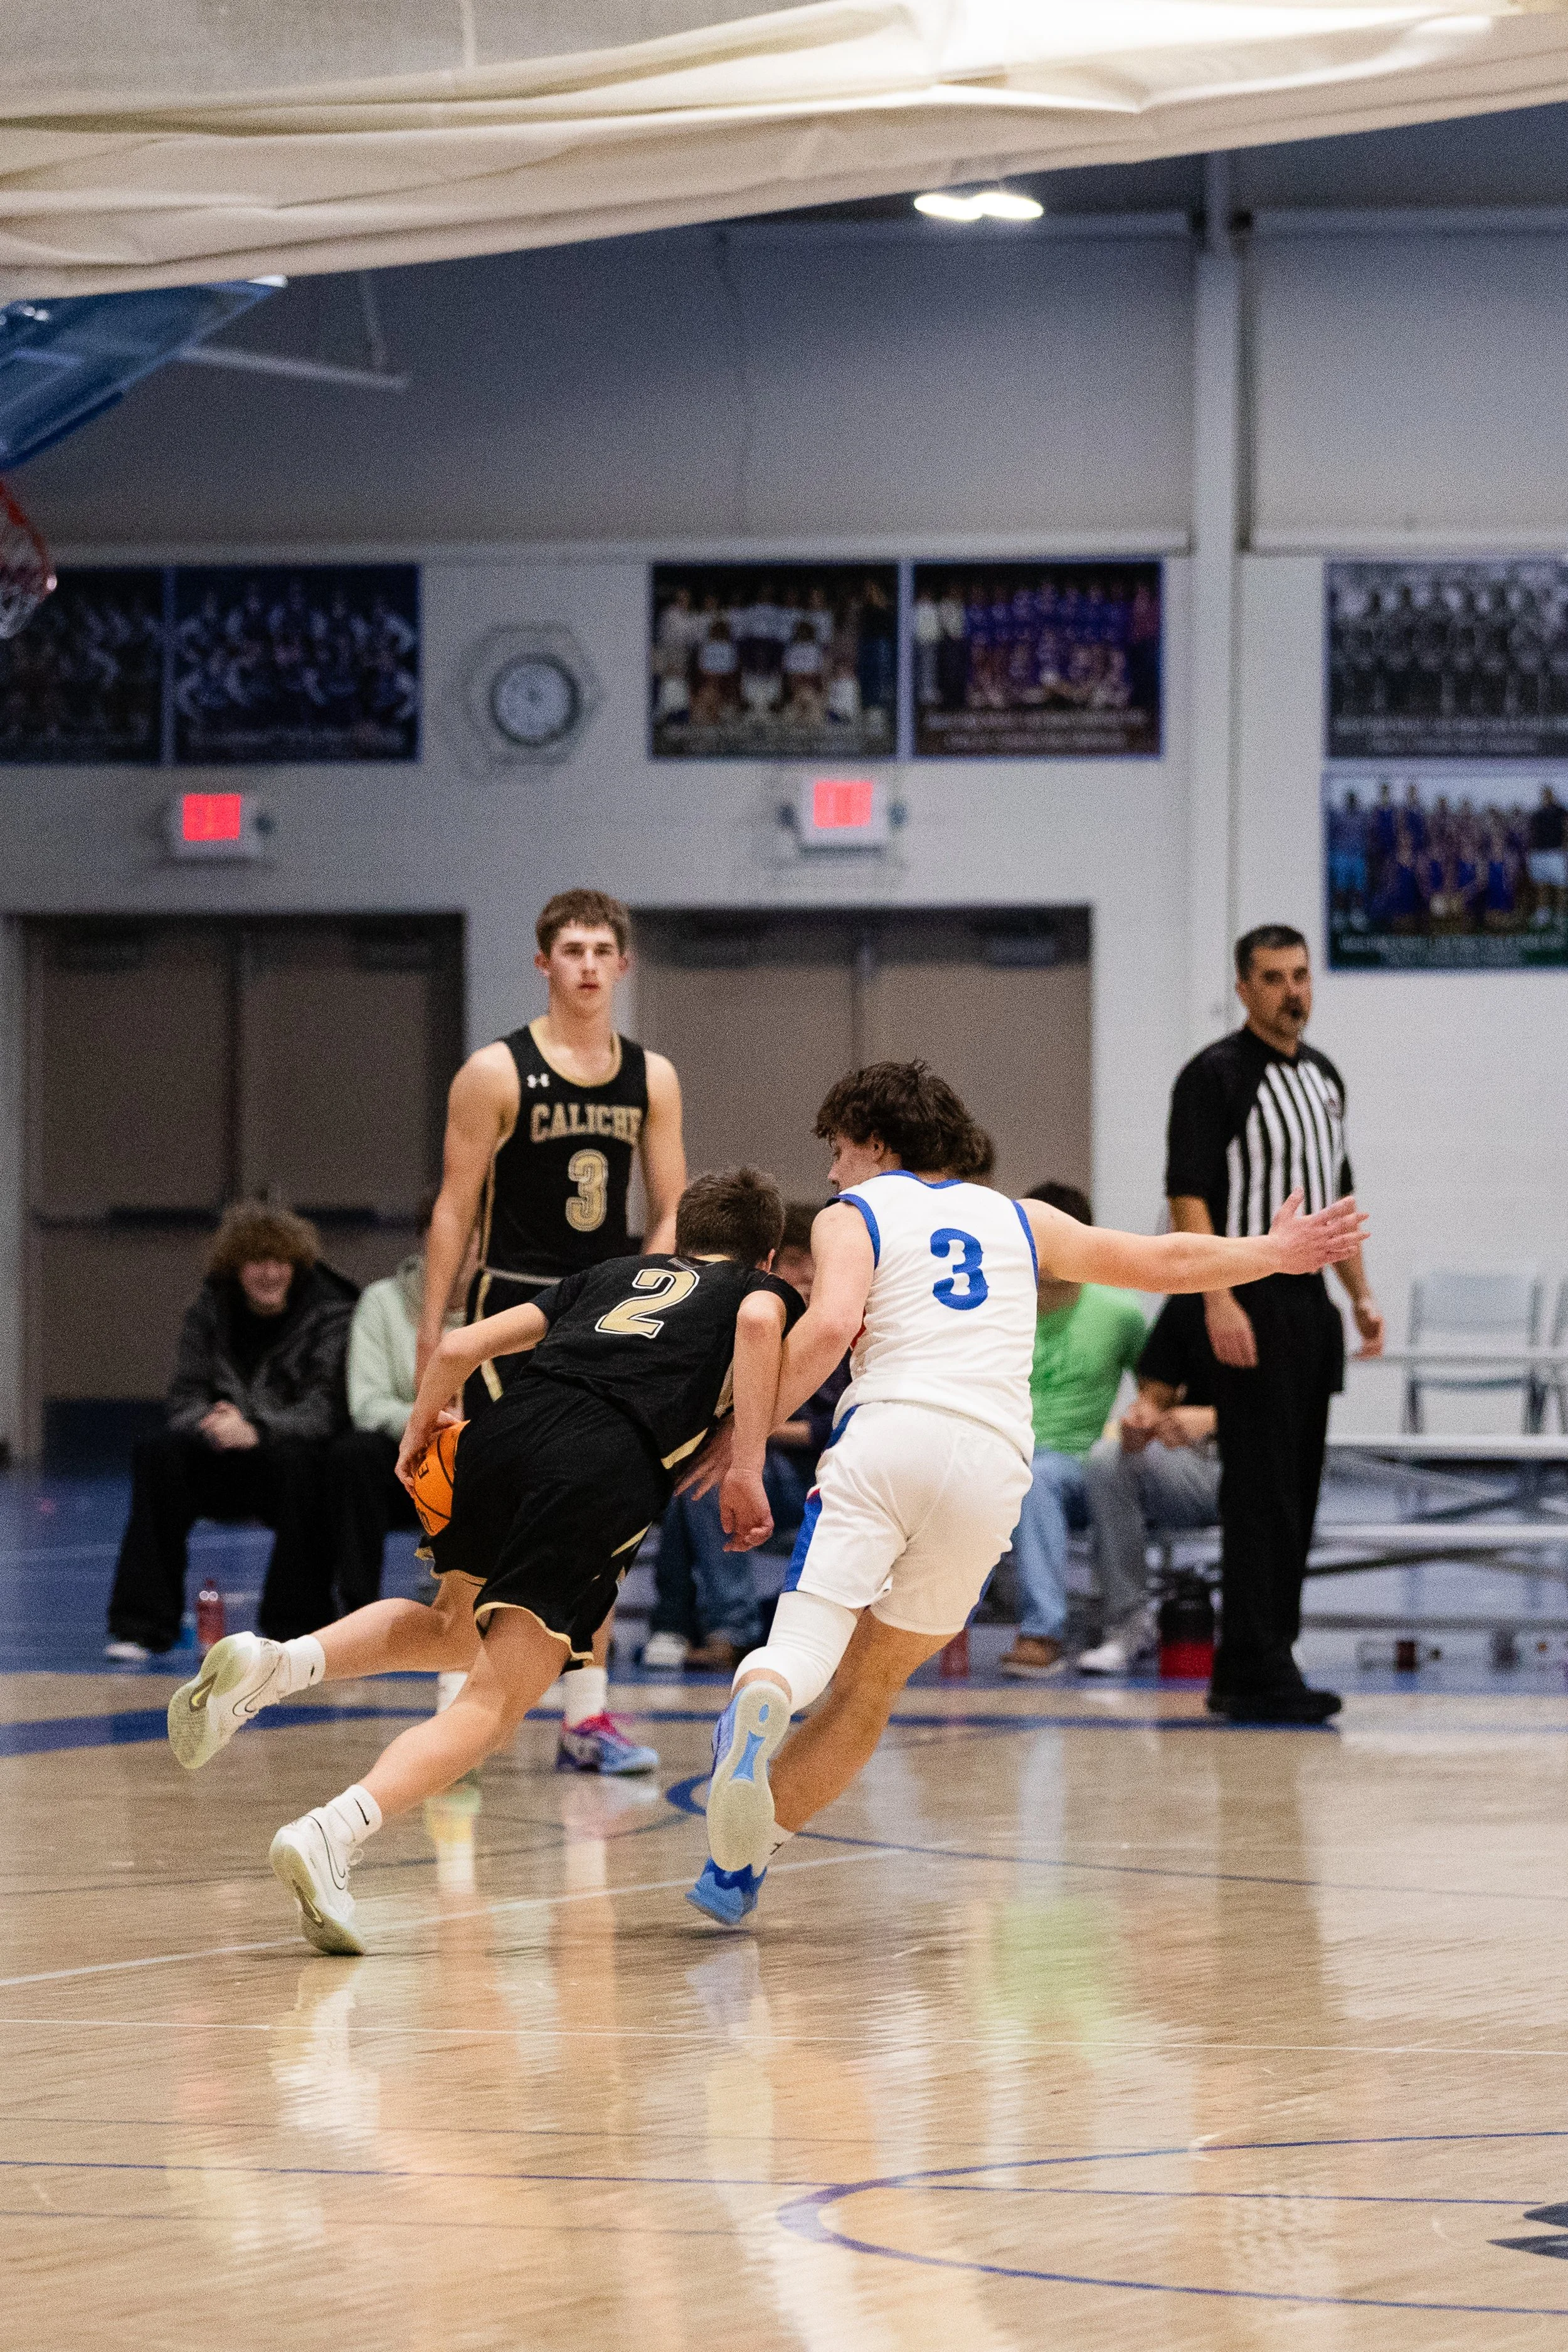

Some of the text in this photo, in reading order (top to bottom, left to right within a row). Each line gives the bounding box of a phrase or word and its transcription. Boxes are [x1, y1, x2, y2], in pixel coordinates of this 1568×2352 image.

[566, 1148, 609, 1232] 3
[595, 1268, 701, 1339] 2
[930, 1227, 990, 1311] 3
